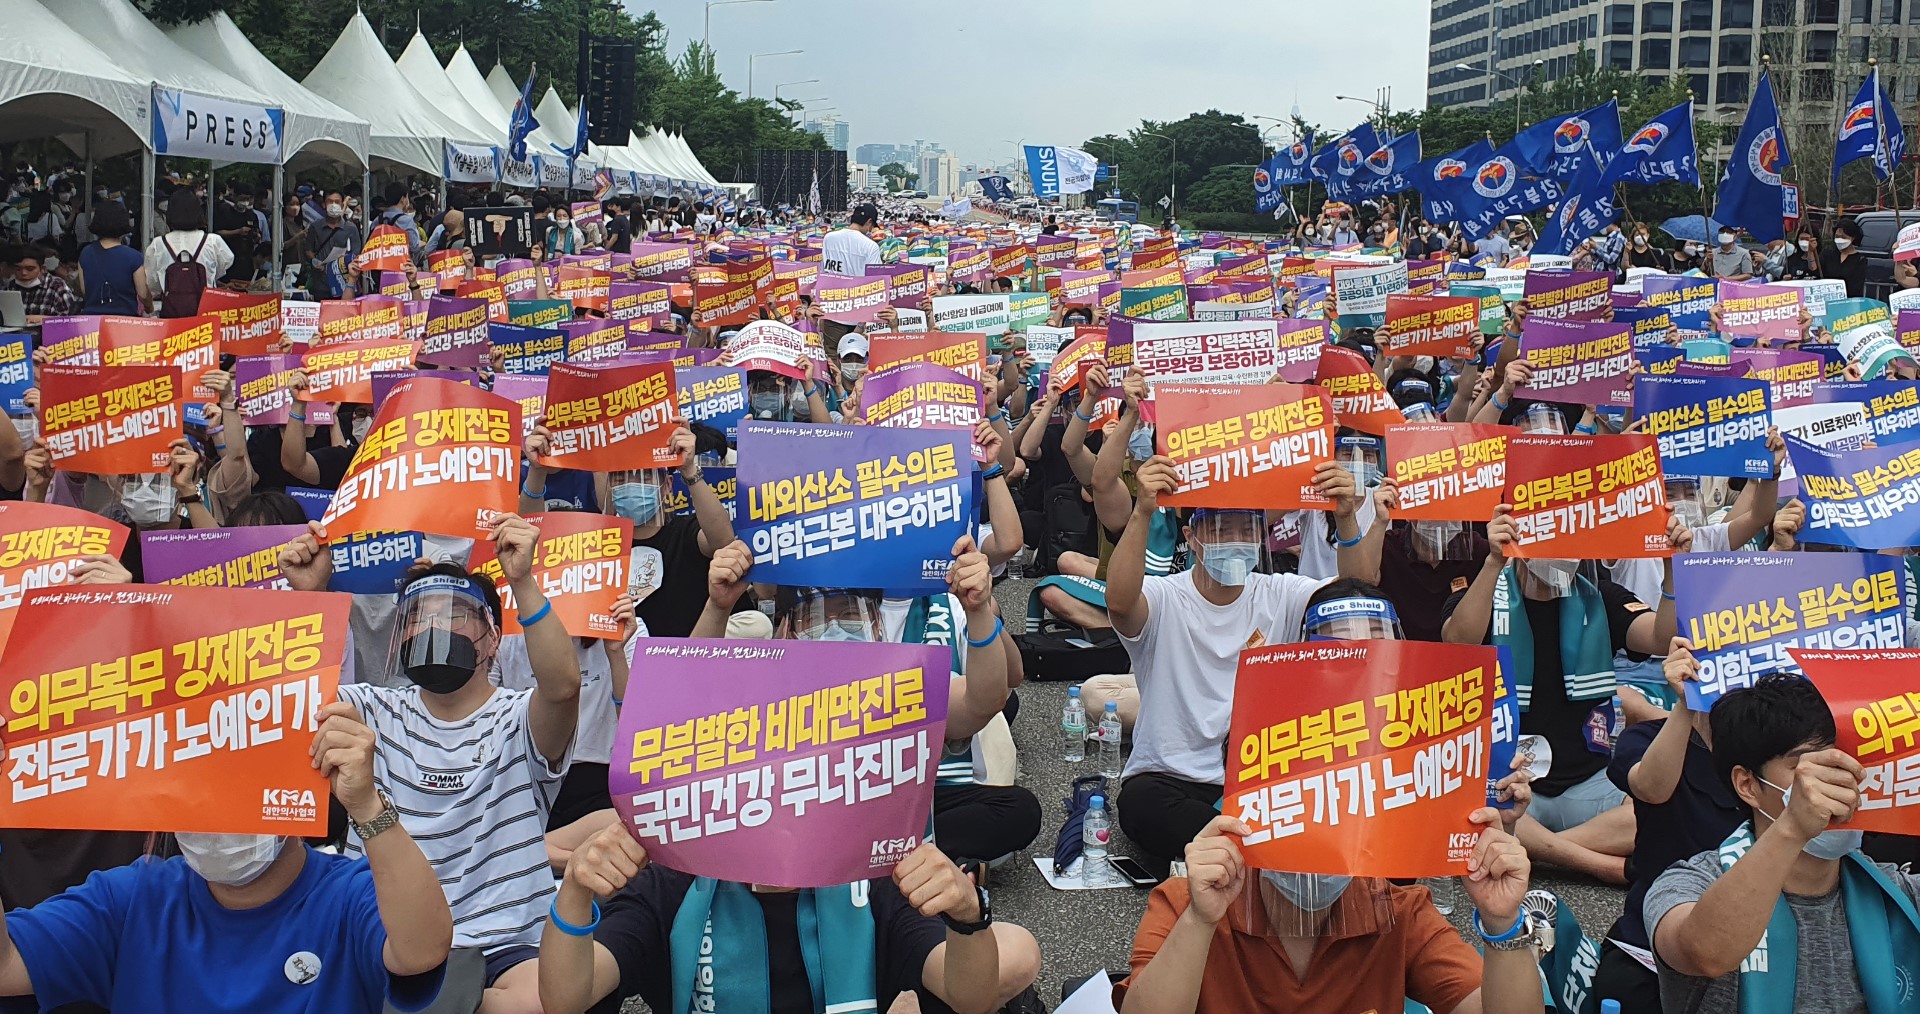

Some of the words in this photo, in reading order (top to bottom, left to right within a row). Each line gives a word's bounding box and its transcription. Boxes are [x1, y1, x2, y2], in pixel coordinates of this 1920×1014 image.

[186, 110, 268, 149] PRESS
[1039, 148, 1057, 194] SNUH
[634, 254, 659, 267] 무분별한
[659, 247, 690, 262] 비대면진료
[637, 263, 663, 277] 국민건강
[663, 257, 691, 272] 무너진다
[560, 278, 587, 290] 의무복무
[587, 276, 611, 287] 강제전공
[820, 287, 849, 301] 무분별한
[849, 279, 886, 299] 비대면진료
[894, 269, 925, 287] 비대면진료
[897, 281, 926, 300] 무너진다
[1336, 276, 1374, 291] 대화통해
[611, 294, 637, 310] 무분별한
[637, 288, 668, 304] 비대면진료
[699, 296, 726, 311] 의무복무
[725, 283, 754, 303] 강제전공
[729, 293, 757, 315] 노예인가
[820, 300, 853, 314] 국민건강
[853, 292, 887, 310] 무너진다
[1152, 290, 1184, 310] 잊었는가
[1339, 287, 1375, 301] 공공의료
[1526, 291, 1565, 309] 무분별한
[1566, 276, 1609, 302] 비대면진료
[1568, 292, 1610, 317] 무너진다
[1647, 291, 1682, 307] 내외산소
[1682, 283, 1715, 301] 필수의료
[1722, 297, 1756, 312] 무분별한
[1756, 291, 1799, 309] 비대면진료
[240, 299, 278, 322] 강제전공
[323, 314, 364, 336] 보장성강화
[365, 306, 398, 327] 생색말고
[447, 304, 487, 332] 비대면진료
[612, 305, 642, 321] 국민건강
[641, 300, 670, 316] 무너진다
[970, 301, 1004, 316] 비급여에
[1389, 315, 1431, 335] 의무복무
[1433, 302, 1474, 325] 강제전공
[1682, 299, 1715, 316] 대우하라
[1723, 309, 1760, 327] 국민건강
[1761, 303, 1801, 322] 무너진다
[241, 316, 280, 340] 노예인가
[453, 323, 489, 349] 무너진다
[587, 324, 626, 345] 비대면진료
[1280, 325, 1325, 349] 비대면진료
[1389, 331, 1431, 351] 전문가가
[1432, 320, 1475, 341] 노예인가
[1635, 313, 1671, 333] 필수의료
[104, 341, 160, 367] 의무복무
[162, 322, 214, 356] 강제전공
[307, 351, 360, 372] 의무복무
[361, 343, 413, 362] 강제전공
[524, 335, 565, 355] 필수의료
[592, 340, 627, 359] 무너진다
[1136, 337, 1200, 360] 수련병원
[1205, 330, 1274, 353] 인력착취
[1525, 344, 1578, 369] 무분별한
[1578, 330, 1631, 360] 비대면진료
[524, 350, 565, 372] 대우하라
[1138, 354, 1204, 376] 근무환경
[1207, 351, 1275, 371] 보장하라
[1524, 366, 1582, 392] 국민건강
[1581, 353, 1634, 382] 무너진다
[1776, 360, 1820, 382] 비대면진료
[240, 374, 278, 401] 무분별한
[308, 363, 359, 394] 전문가가
[692, 373, 742, 401] 필수의료
[45, 399, 101, 431] 의무복무
[102, 375, 173, 415] 강제전공
[547, 396, 602, 428] 의무복무
[602, 371, 668, 414] 강제전공
[693, 391, 744, 422] 대우하라
[866, 391, 916, 426] 무분별한
[916, 381, 977, 410] 비대면진료
[1642, 404, 1707, 436] 내외산소
[1706, 388, 1766, 420] 필수의료
[1870, 386, 1919, 417] 필수의료
[413, 407, 511, 447] 강제전공
[550, 424, 607, 456] 전문가가
[608, 399, 674, 442] 노예인가
[924, 404, 982, 427] 무너진다
[1167, 417, 1244, 459] 의무복무
[1245, 396, 1324, 440] 강제전공
[1811, 411, 1862, 437] 의료취약?
[1874, 406, 1920, 436] 대우하라
[47, 424, 105, 460] 전문가가
[106, 403, 177, 444] 노예인가
[1707, 414, 1769, 449] 대우하라
[412, 446, 514, 487] 노예인가
[1173, 453, 1249, 494] 전문가가
[1251, 428, 1329, 473] 노예인가
[1395, 452, 1457, 482] 의무복무
[1802, 472, 1857, 501] 내외산소
[1855, 447, 1920, 497] 필수의료
[748, 466, 853, 522] 내외산소
[856, 443, 959, 500] 필수의료
[1399, 475, 1461, 510] 전문가가
[1512, 468, 1594, 511] 의무복무
[1596, 446, 1656, 492] 강제전공
[752, 506, 856, 566] 의학근본
[859, 483, 962, 542] 대우하라
[1515, 502, 1596, 546] 전문가가
[1598, 477, 1665, 525] 노예인가
[1809, 500, 1870, 530] 의학근본
[0, 526, 112, 568] 강제전공
[351, 536, 417, 569] 대우하라
[543, 527, 622, 568] 강제전공
[1645, 535, 1668, 544] KMA
[408, 578, 431, 591] Face
[433, 577, 465, 585] Shield
[543, 557, 622, 598] 노예인가
[589, 614, 617, 625] KMA
[1321, 602, 1347, 613] Face
[1350, 599, 1382, 610] Shield
[1689, 597, 1798, 652] 내외산소
[1798, 570, 1900, 630] 필수의료
[7, 648, 166, 733] 의무복무
[173, 612, 324, 698] 강제전공
[629, 705, 761, 784] 무분별한
[765, 667, 927, 752] 비대면진료
[1238, 700, 1370, 783] 의무복무
[1374, 665, 1484, 749] 강제전공
[7, 712, 168, 804] 전문가가
[172, 674, 322, 764] 노예인가
[422, 773, 464, 783] TOMMY
[632, 764, 776, 845] 국민건강
[781, 729, 930, 818] 무너진다
[1237, 761, 1376, 847] 전문가가
[1382, 726, 1484, 812] 노예인가
[263, 789, 316, 806] KMA
[262, 806, 316, 819] 대한의사협회
[871, 836, 917, 856] KMA
[1448, 833, 1479, 849] KMA
